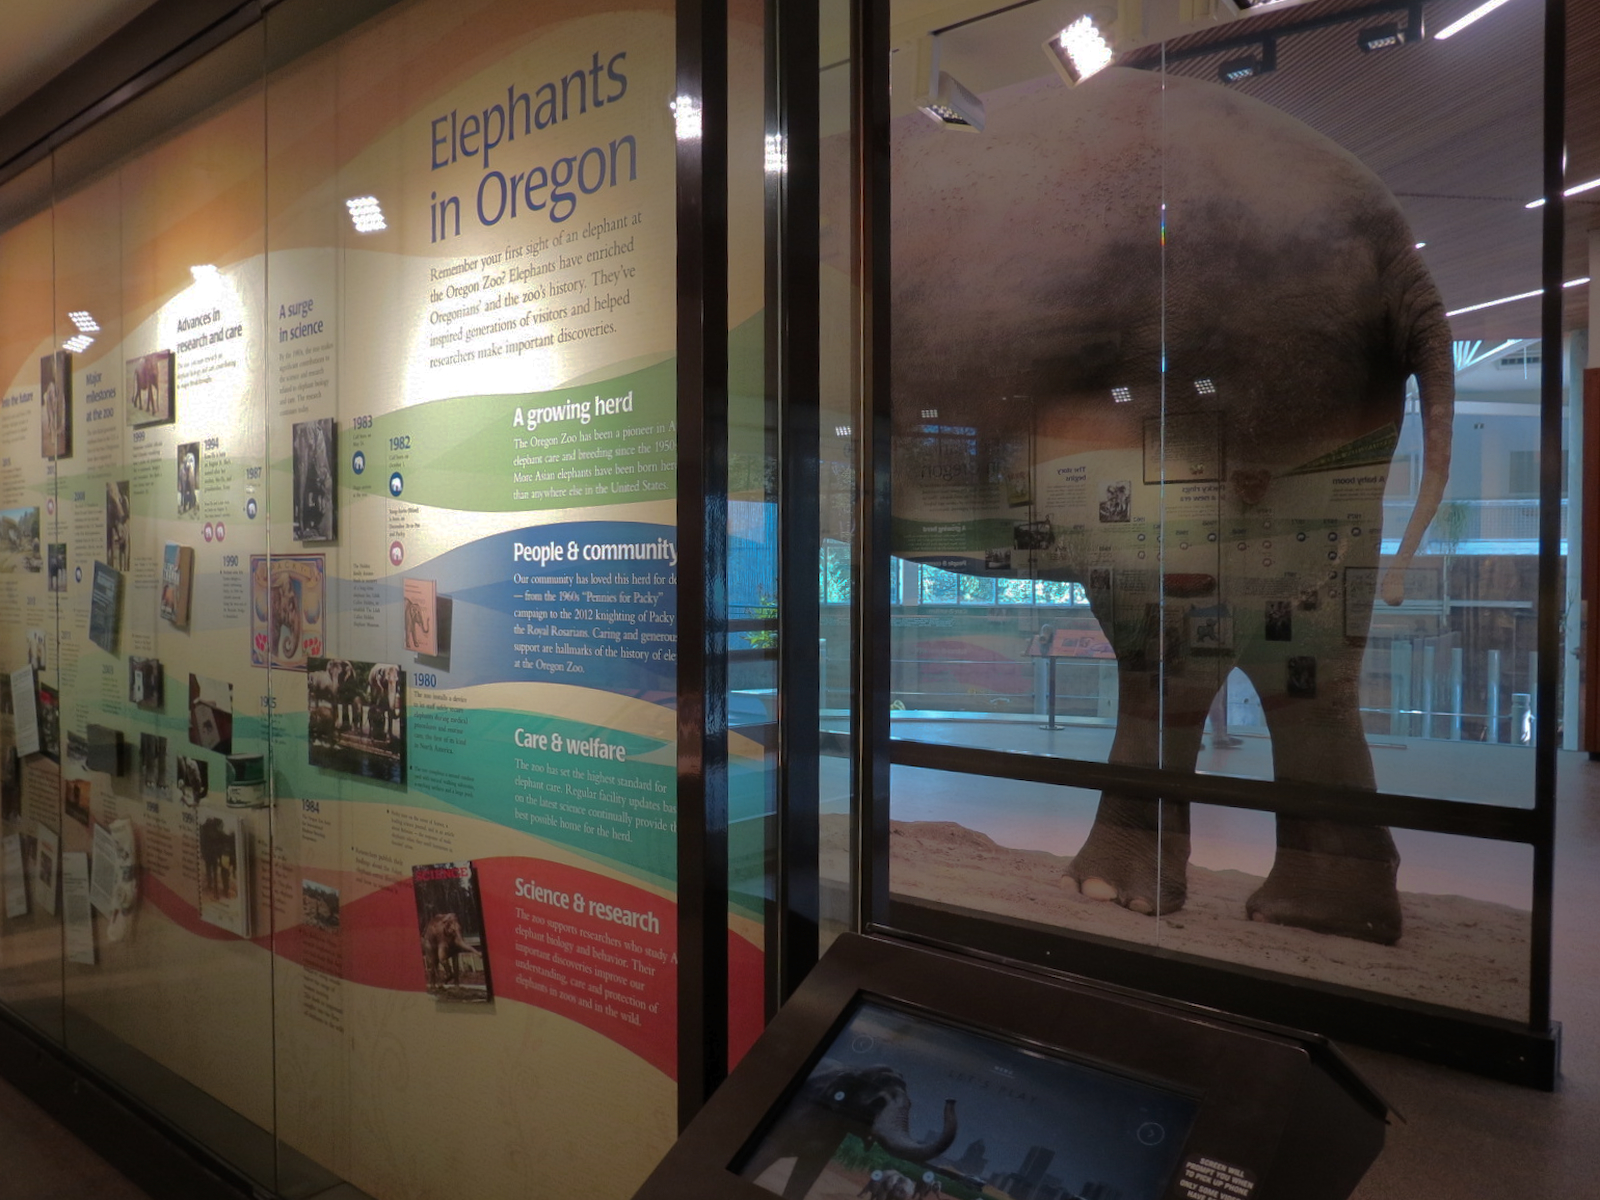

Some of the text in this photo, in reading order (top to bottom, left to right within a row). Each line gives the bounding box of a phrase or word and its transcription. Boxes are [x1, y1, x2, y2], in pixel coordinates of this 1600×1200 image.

[431, 51, 627, 171] Elephants
[431, 134, 637, 243] in Oregon
[431, 212, 642, 281] Remember your first sight of an elephant at
[431, 237, 634, 303] the Oregon Zoo? Elephants have enriched
[485, 297, 500, 312] and
[505, 293, 519, 307] the
[550, 279, 586, 296] history.
[177, 307, 220, 333] Advances in
[279, 299, 313, 319] A surge
[430, 289, 630, 348] inspired generations of visitors and helped
[177, 324, 242, 353] research and care
[279, 320, 323, 343] in science
[430, 321, 616, 368] researchers make important discoveries.
[86, 372, 102, 387] Major
[86, 388, 116, 404] milestones
[353, 415, 372, 430] 1983
[513, 391, 633, 430] A growing herd
[389, 436, 410, 450] 1982
[514, 439, 528, 449] The
[530, 436, 558, 449] Oregon
[561, 433, 577, 444] Zoo
[580, 431, 591, 442] has
[594, 429, 612, 439] been
[616, 430, 619, 438] a
[623, 425, 652, 441] pioneer
[657, 424, 665, 433] in
[513, 451, 542, 468] elephant
[545, 454, 560, 463] care
[562, 450, 575, 461] and
[578, 448, 613, 460] breeding
[615, 445, 635, 455] since
[638, 443, 650, 453] the
[246, 467, 262, 479] 1987
[514, 471, 532, 483] More
[535, 471, 555, 481] Asian
[558, 465, 591, 482] elephants
[595, 465, 612, 476] have
[615, 462, 634, 474] been
[638, 461, 657, 472] born
[223, 556, 238, 567] 1990
[514, 538, 677, 567] People & community
[514, 573, 528, 584] Our
[531, 575, 573, 586] community
[576, 573, 588, 584] has
[591, 573, 612, 584] loved
[615, 573, 629, 584] this
[632, 573, 651, 584] herd
[654, 573, 665, 584] for
[525, 590, 542, 601] from
[545, 591, 556, 601] the
[559, 591, 579, 601] 1960s
[619, 592, 631, 603] for
[514, 609, 548, 621] campaign
[560, 609, 572, 619] the
[575, 609, 593, 620] 2012
[596, 610, 635, 624] knighting
[638, 611, 648, 621] of
[650, 611, 674, 625] Packy
[414, 673, 436, 687] 1980
[515, 728, 626, 762] Care & welfare
[515, 758, 667, 793] The zoo has set the highest standard for
[302, 799, 320, 813] 1984
[515, 777, 660, 811] elephant care. Regular facility updates
[415, 867, 468, 881] SCIENCE
[515, 878, 660, 934] Science & research
[516, 907, 668, 963] The zoo supports researchers who study
[1186, 1162, 1254, 1189] PROMPT YOU WHEN
[1200, 1158, 1244, 1178] SCREEN WILL
[1180, 1180, 1198, 1190] ONLY
[1198, 1186, 1219, 1198] SOME
[1185, 1169, 1195, 1178] TO
[1195, 1173, 1212, 1184] PICK
[1224, 1183, 1248, 1196] PHONE
